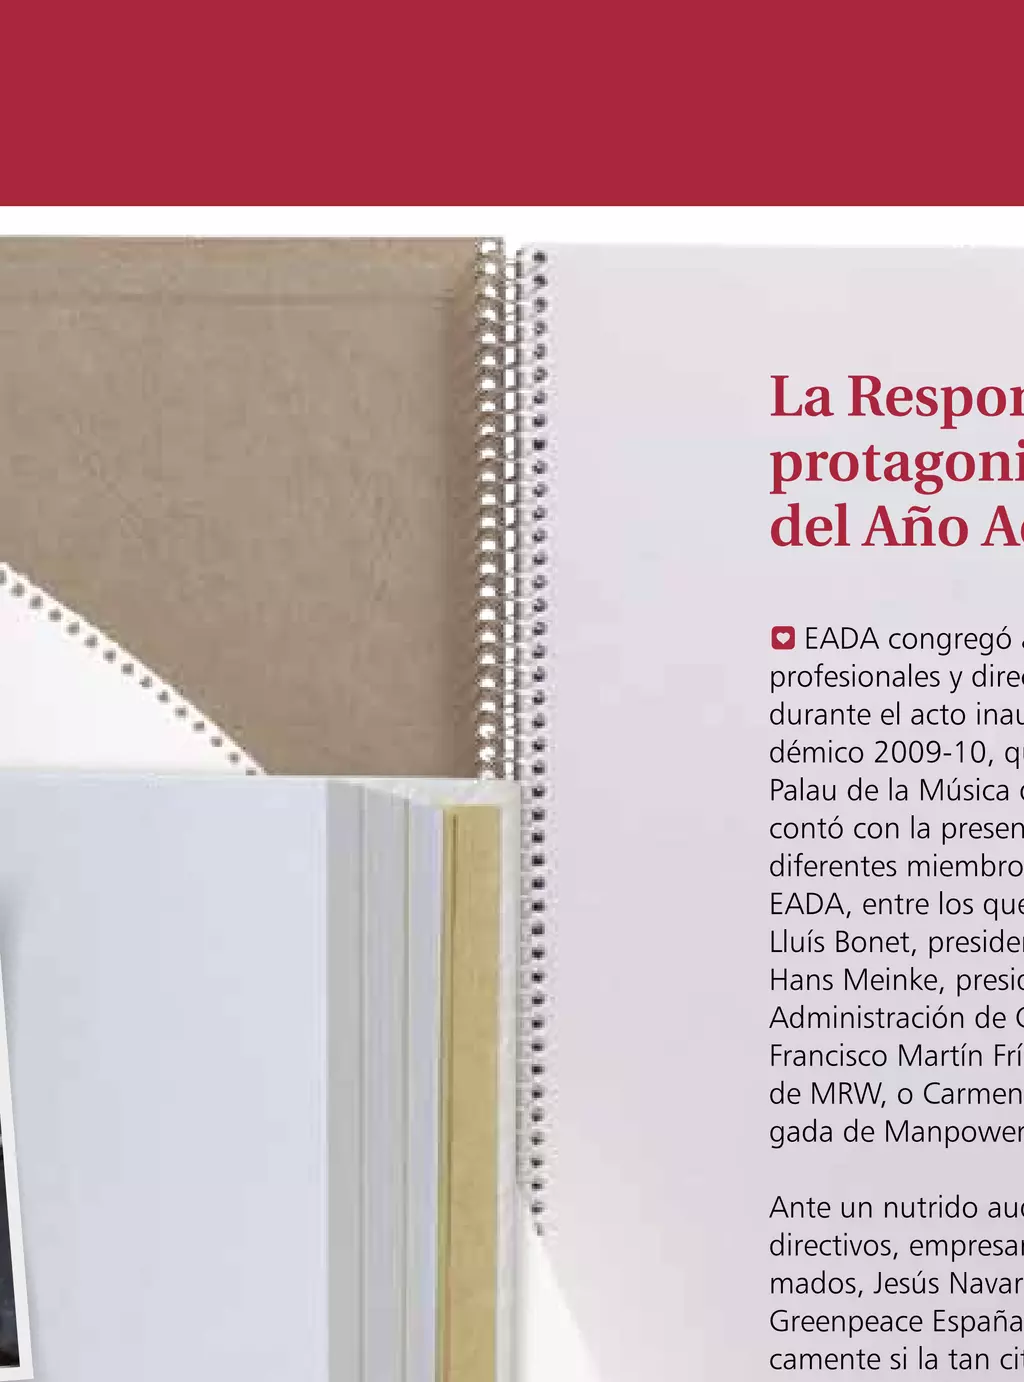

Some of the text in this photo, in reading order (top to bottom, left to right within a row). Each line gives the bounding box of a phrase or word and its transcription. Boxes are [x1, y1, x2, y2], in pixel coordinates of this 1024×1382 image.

[770, 375, 835, 417] La
[770, 502, 851, 547] del
[860, 505, 969, 547] Año
[806, 626, 880, 650] EADA
[888, 625, 1012, 657] congregó
[770, 662, 941, 694] profesionales
[949, 670, 963, 694] y
[769, 738, 864, 764] démico
[874, 740, 994, 768] 2009-10,
[770, 928, 825, 953] Lluís
[835, 930, 917, 957] Bonet,
[770, 1042, 888, 1067] Francisco
[898, 1042, 983, 1067] Martín
[769, 1080, 801, 1105] de
[811, 1081, 886, 1109] MRW,
[897, 1087, 913, 1105] o
[923, 1081, 1023, 1105] Carmen
[769, 1231, 898, 1261] directivos,
[769, 1309, 923, 1339] Greenpeace
